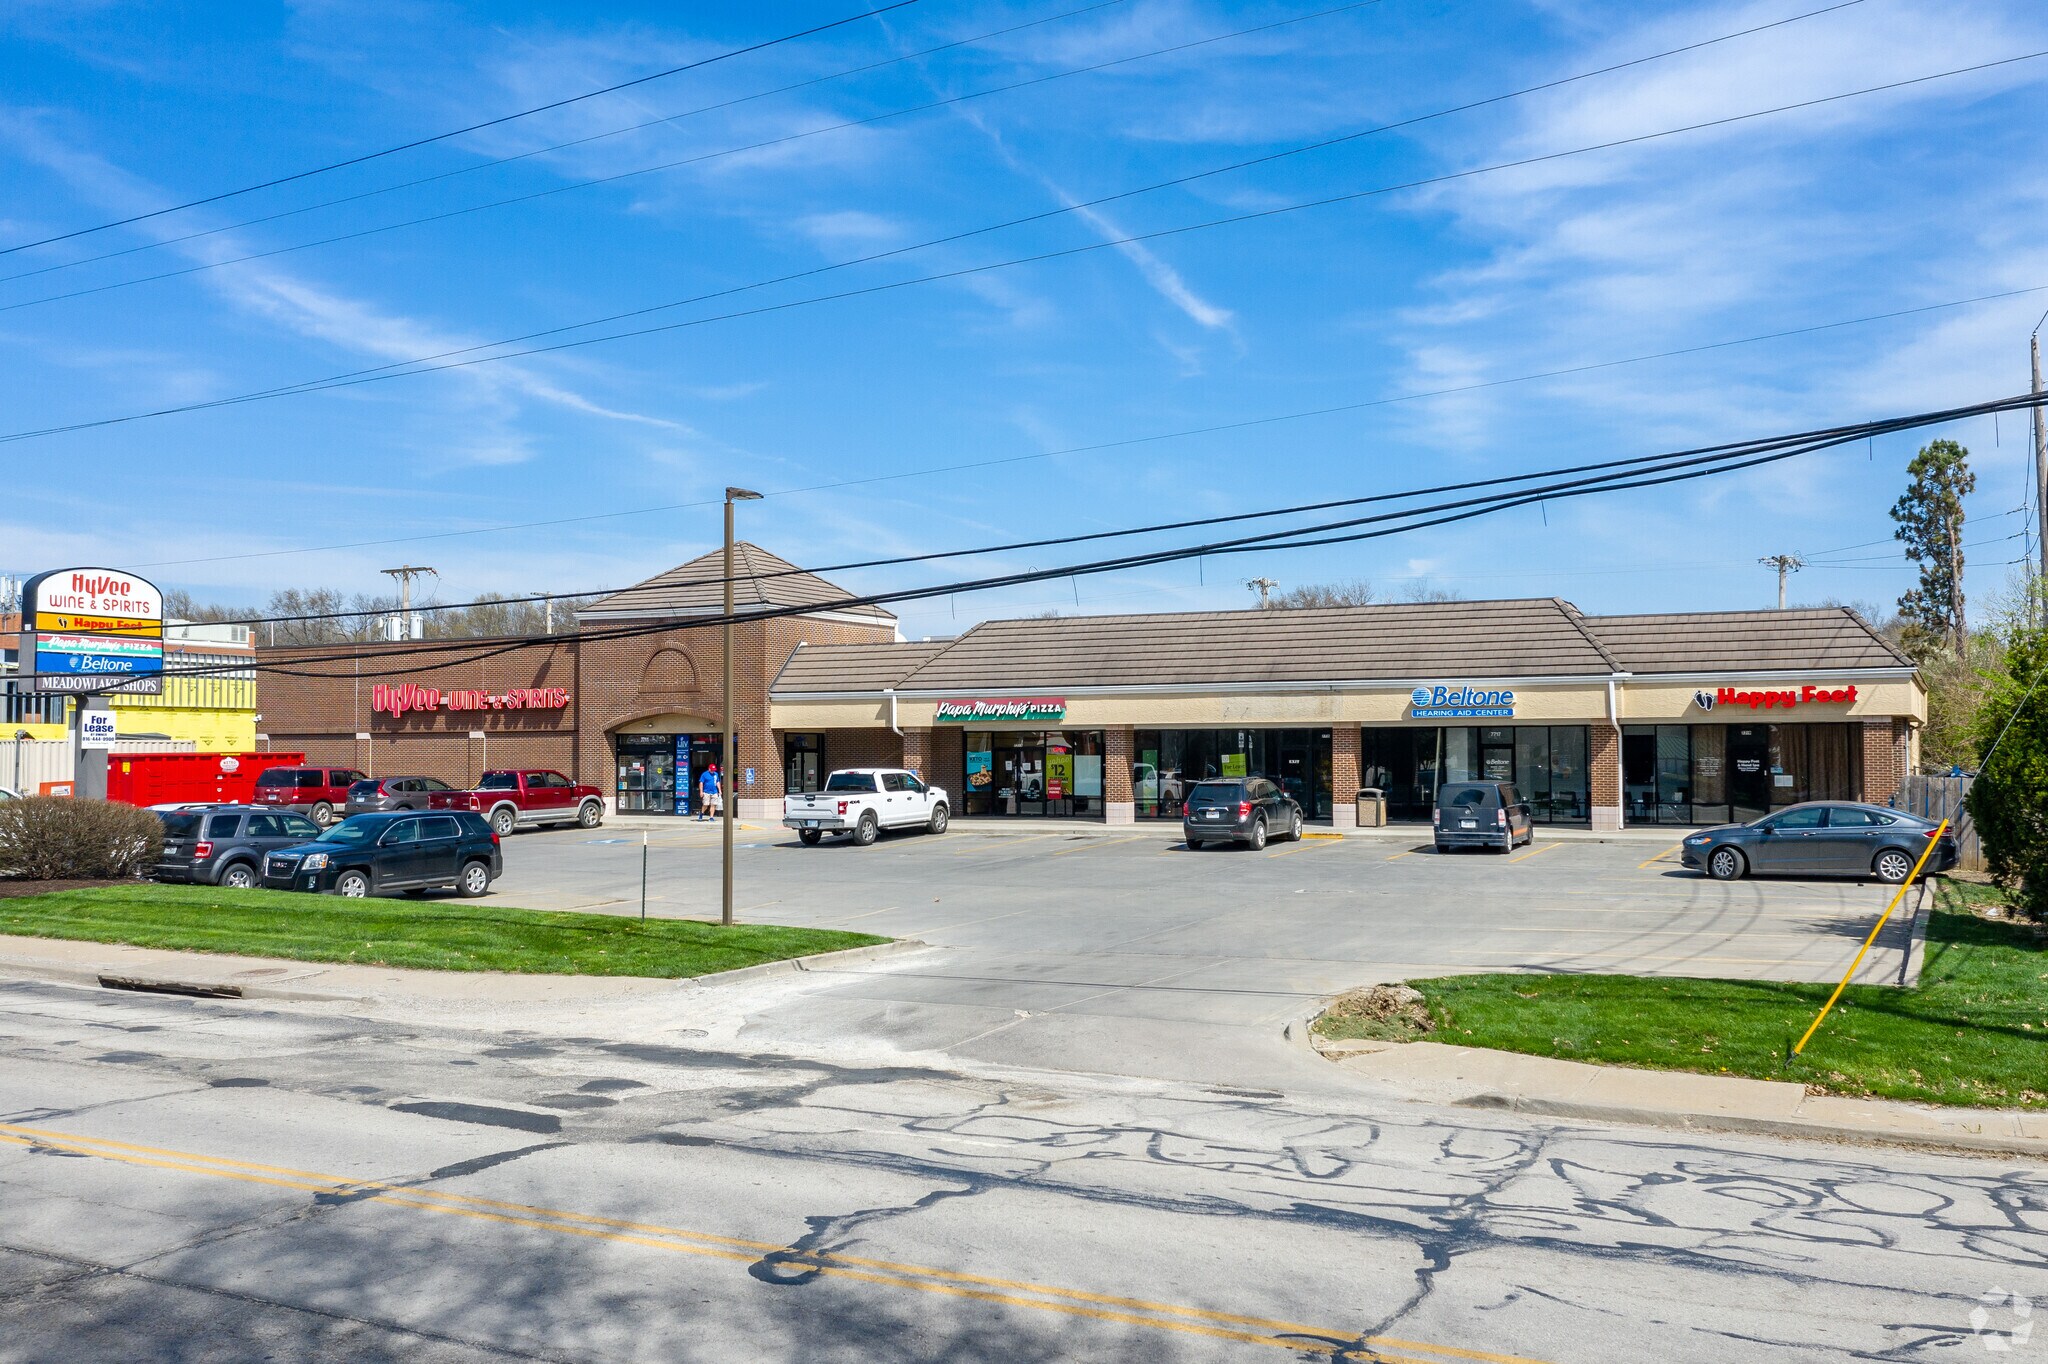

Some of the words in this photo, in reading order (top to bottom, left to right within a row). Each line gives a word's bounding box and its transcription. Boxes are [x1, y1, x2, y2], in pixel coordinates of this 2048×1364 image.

[72, 573, 131, 598] HyVee
[49, 595, 84, 609] WINE
[90, 600, 97, 610] &
[103, 598, 150, 614] SPIRITS
[74, 617, 114, 632] Happy
[48, 636, 77, 650] Papa
[123, 642, 153, 652] PIZZA
[81, 656, 133, 671] Beltone
[123, 678, 157, 692] SHOPS
[372, 684, 441, 719] HyVee
[447, 689, 490, 710] WINE
[492, 695, 504, 710] &
[506, 687, 567, 710] SPIRITS
[1430, 685, 1514, 707] Beltone
[1717, 687, 1796, 709] Happy
[1801, 685, 1858, 703] Feet
[936, 701, 973, 718] Papa
[973, 700, 1030, 718] Murphy's
[1030, 704, 1062, 713] PIZZA
[91, 715, 108, 724] For
[84, 723, 114, 733] Lease
[1050, 764, 1065, 776] $12
